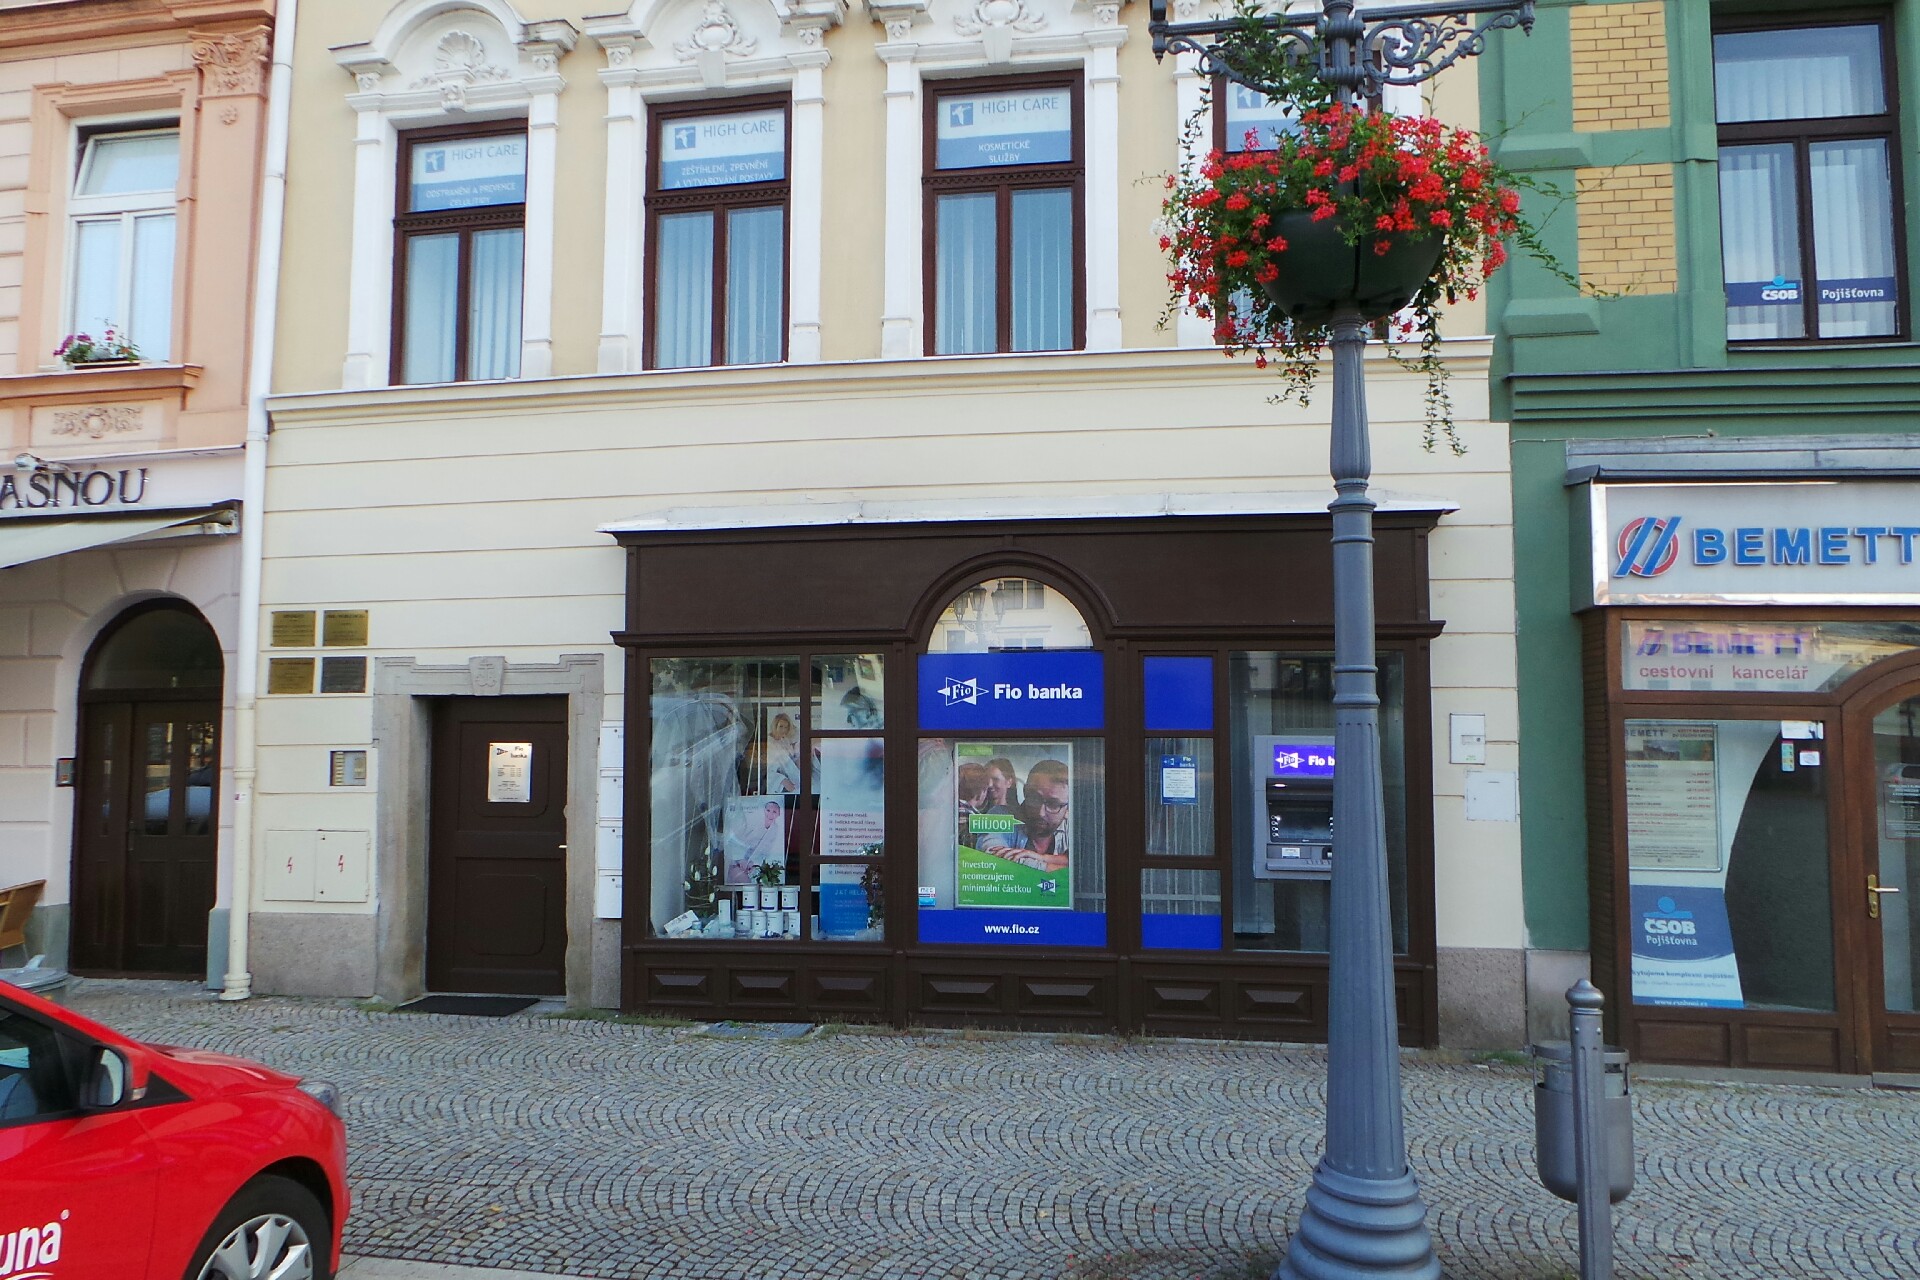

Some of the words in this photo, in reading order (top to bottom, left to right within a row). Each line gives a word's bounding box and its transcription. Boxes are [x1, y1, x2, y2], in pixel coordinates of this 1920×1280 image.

[982, 99, 1017, 114] HIGH
[1022, 97, 1059, 111] CARE
[703, 125, 736, 138] HIGH
[741, 119, 775, 134] CARE
[452, 149, 482, 161] HIGH
[487, 144, 519, 158] CARE
[978, 140, 1030, 152] KOSMETICKÉ
[988, 152, 1020, 163] SLUŽBY
[1762, 289, 1799, 301] ČSOB
[1822, 287, 1884, 302] Pojišťovna
[1694, 526, 1920, 566] BEMETT
[1639, 664, 1714, 679] cestovní
[1732, 664, 1809, 680] kancelář
[952, 684, 971, 699] Fio
[994, 683, 1022, 699] Fio
[1028, 683, 1082, 699] banka
[1308, 755, 1325, 766] Fio
[962, 860, 997, 871] Investory
[962, 873, 1014, 883] neomezujeme
[962, 884, 1000, 893] minimální
[1002, 884, 1032, 894] částkou
[984, 923, 1040, 934] www.fio.cz
[1644, 918, 1696, 935] ČSOB
[1647, 935, 1698, 946] Pojišťovna
